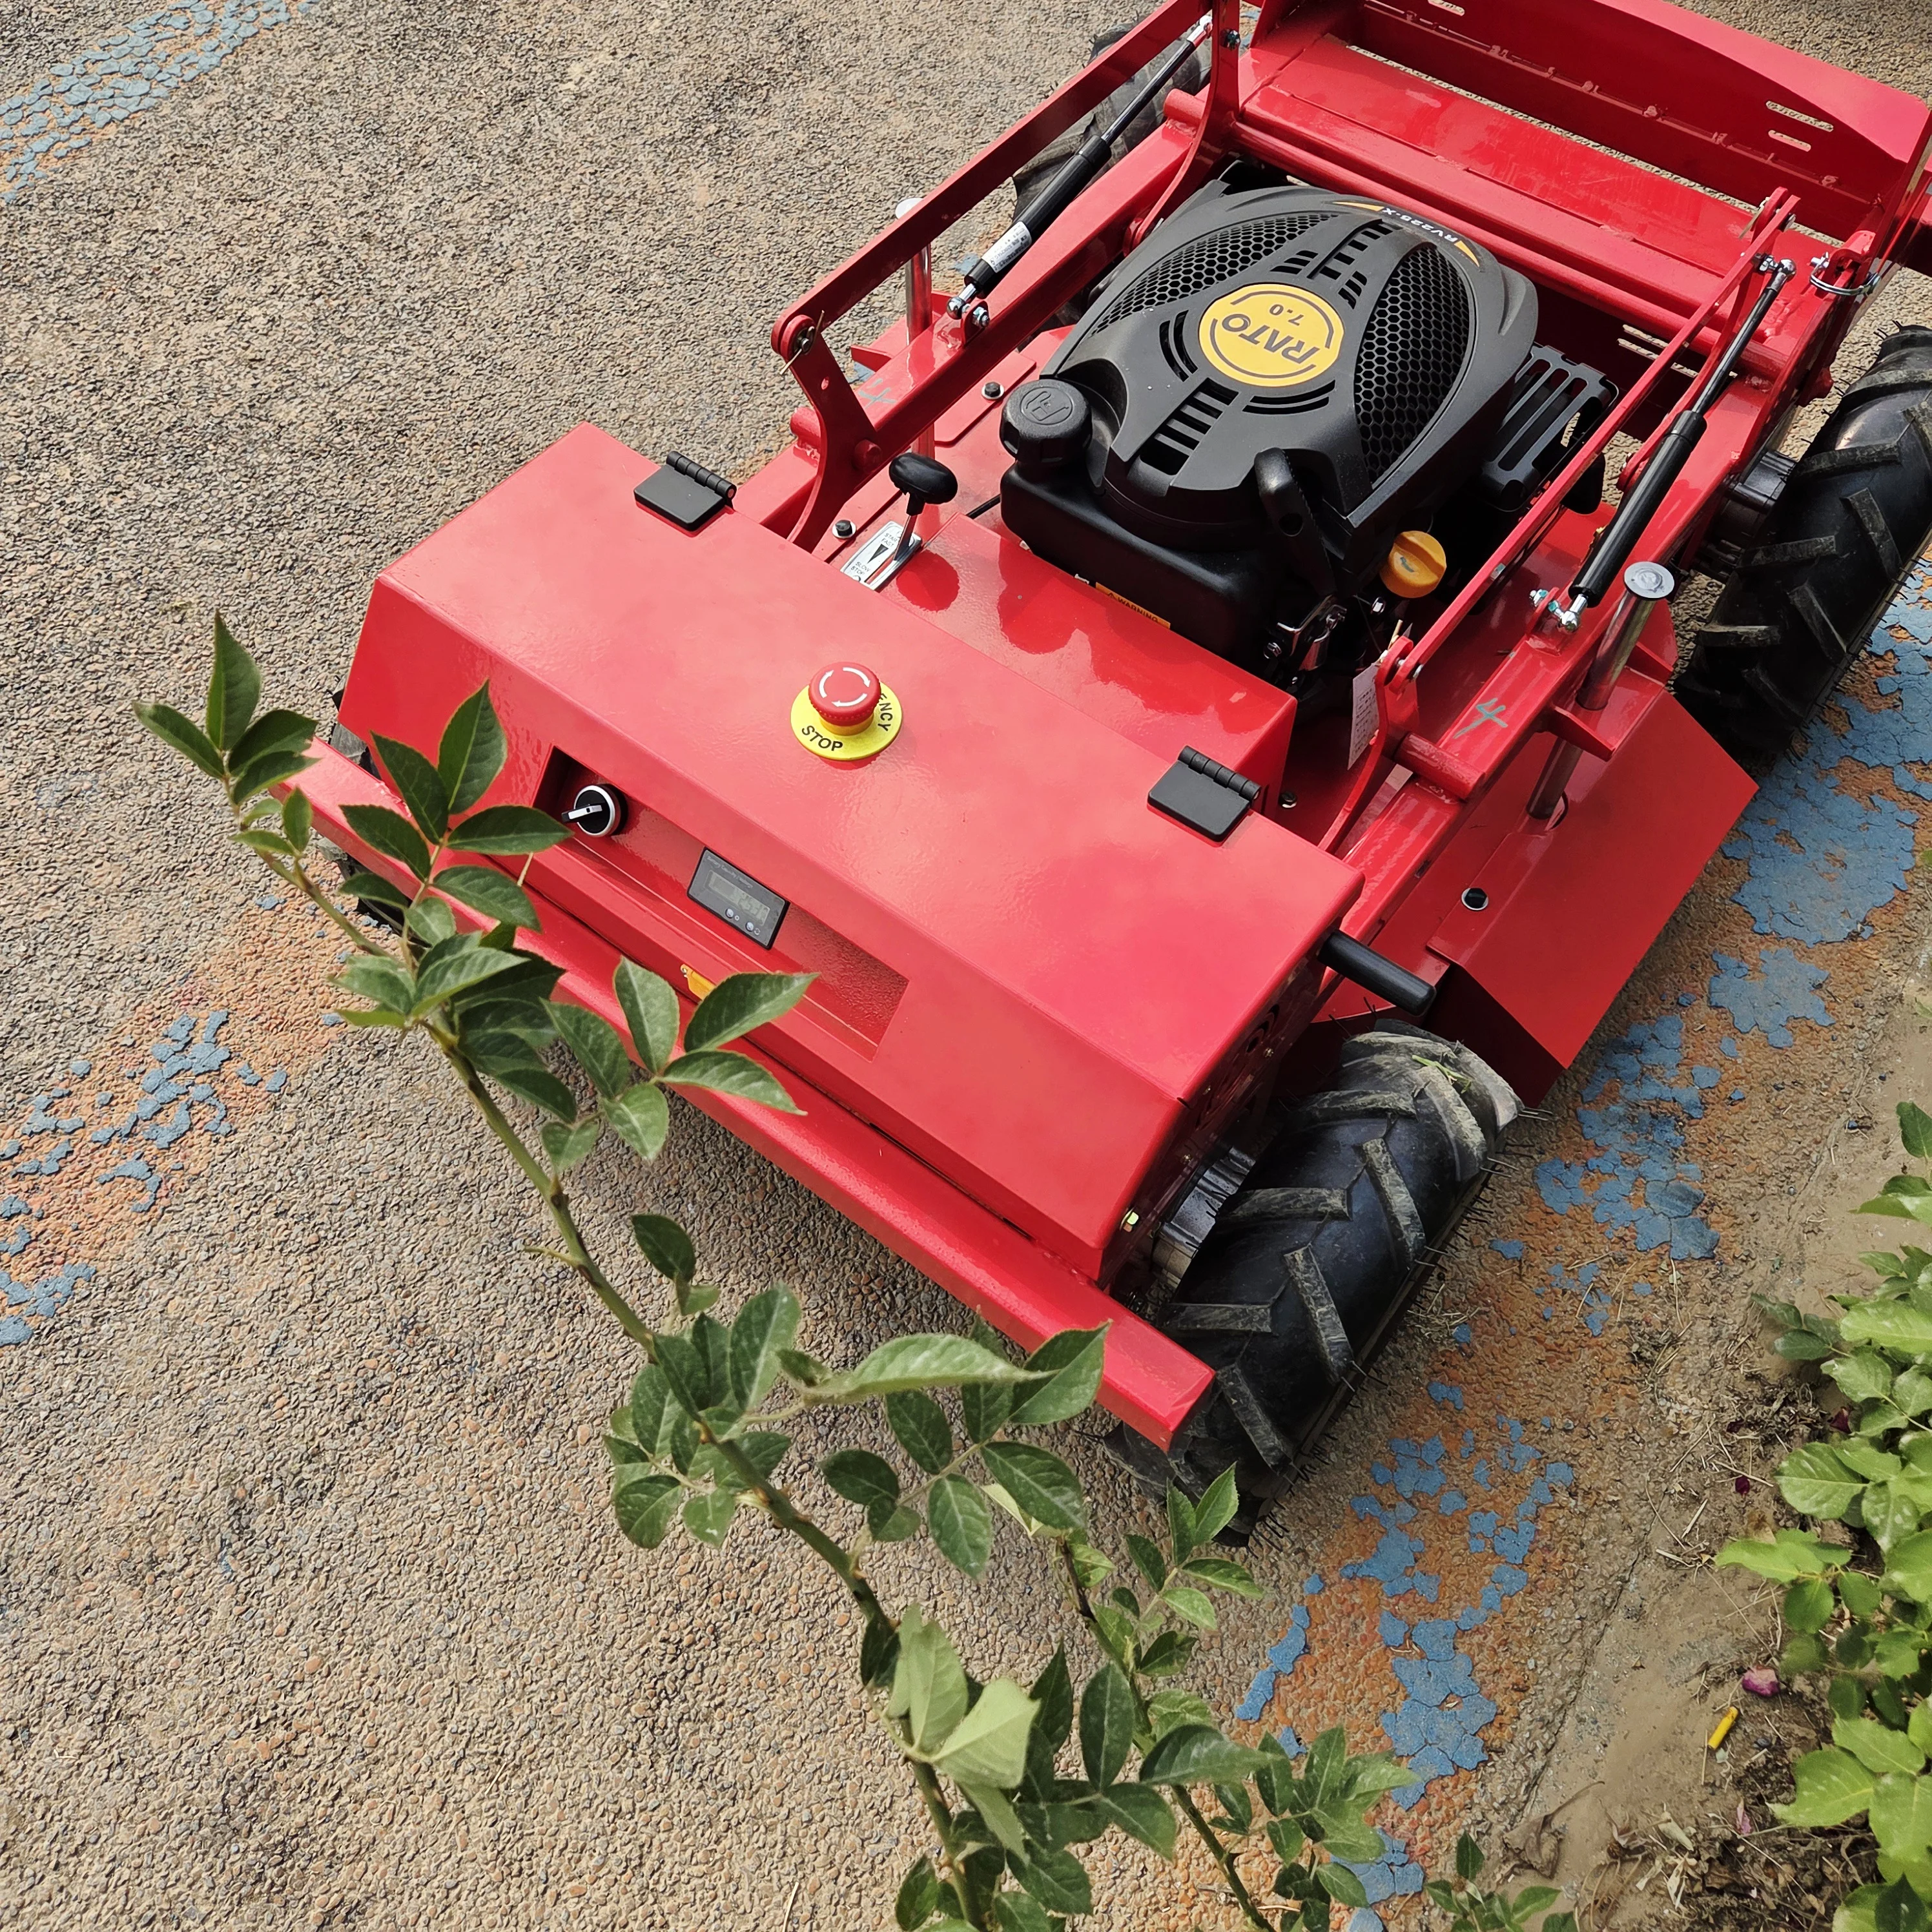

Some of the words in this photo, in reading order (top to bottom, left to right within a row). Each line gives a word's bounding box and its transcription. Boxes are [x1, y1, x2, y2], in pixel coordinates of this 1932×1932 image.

[1382, 207, 1459, 243] RV225-X
[1269, 303, 1304, 326] 7.0
[1221, 313, 1321, 364] RATO
[881, 537, 895, 547] FAST
[884, 532, 898, 543] STAR
[850, 565, 865, 575] STOP
[856, 561, 871, 572] SLOW
[801, 724, 844, 752] STOP
